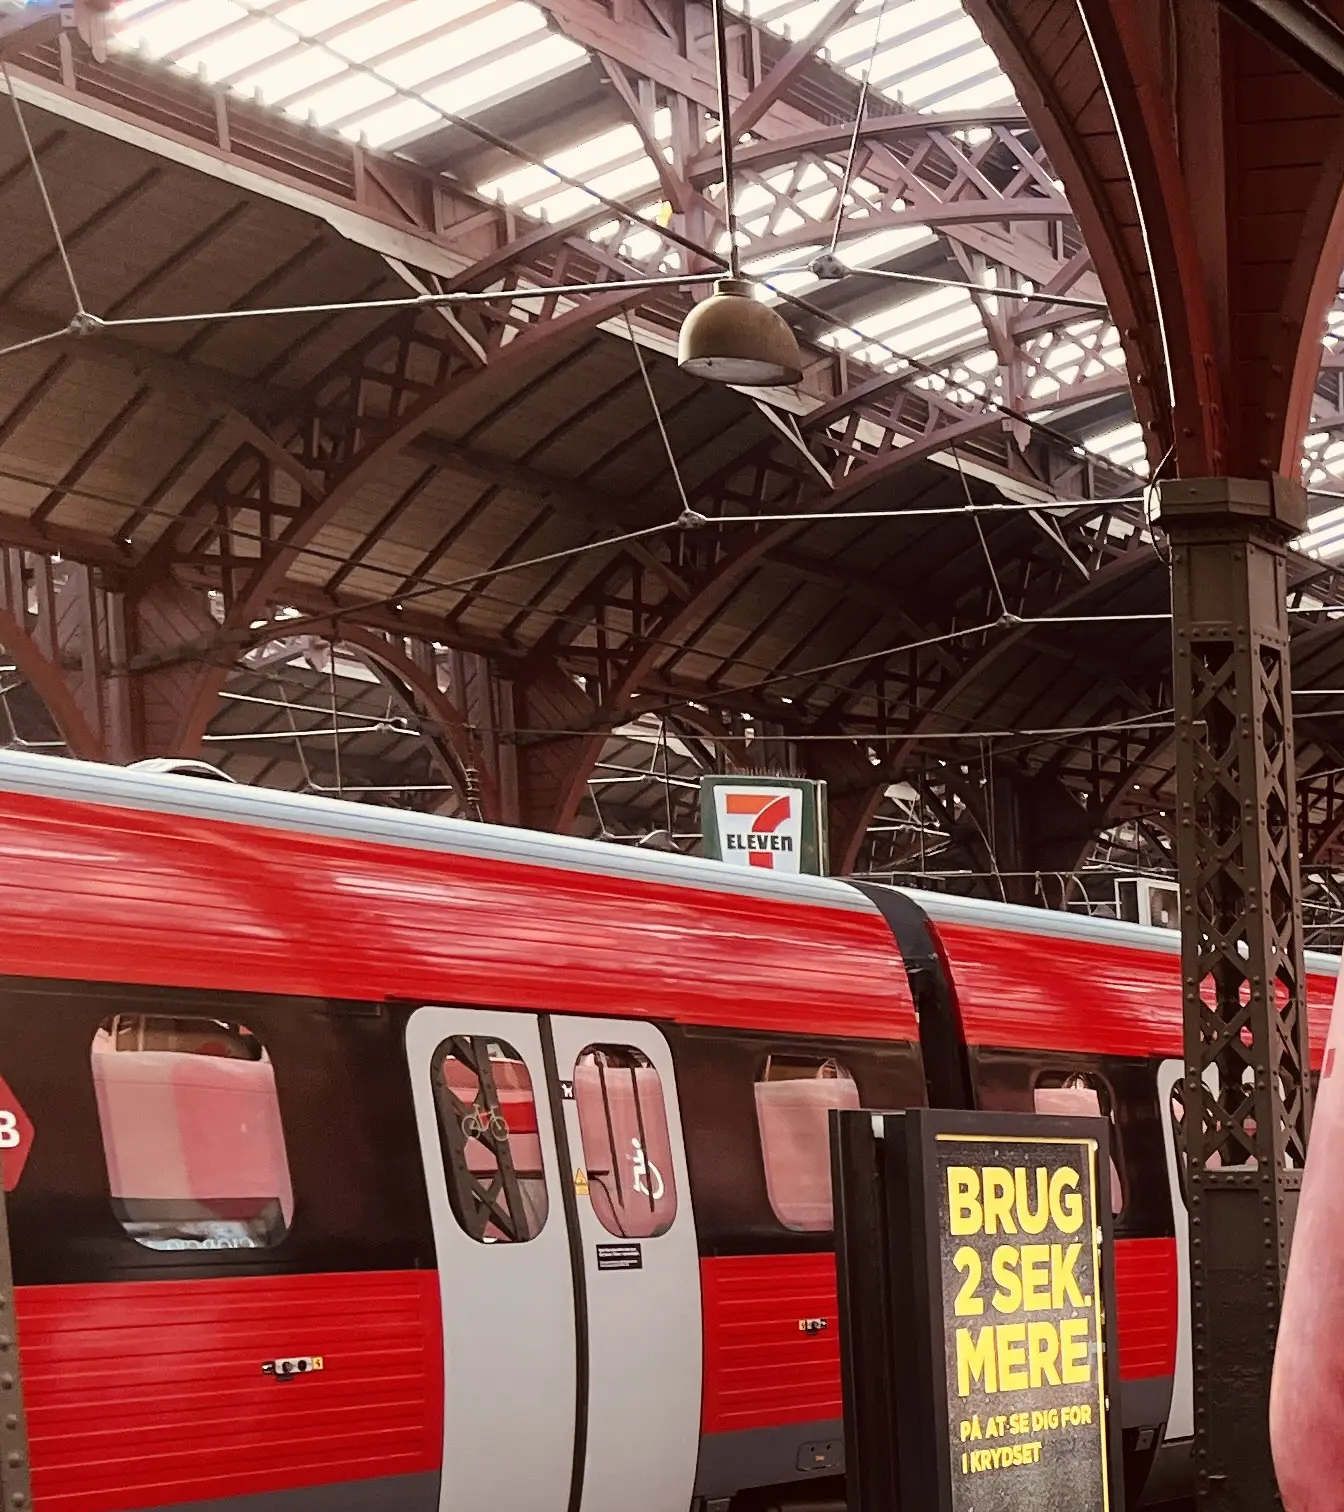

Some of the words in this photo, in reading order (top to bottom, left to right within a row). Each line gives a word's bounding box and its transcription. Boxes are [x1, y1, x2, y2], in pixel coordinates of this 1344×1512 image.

[726, 793, 791, 869] 7
[947, 1166, 1083, 1236] BRUG
[953, 1245, 984, 1316] 2
[991, 1242, 1092, 1315] SEK.
[956, 1318, 1090, 1397] MERE
[960, 1414, 982, 1442] PÅ
[985, 1415, 1007, 1438] AT
[1010, 1412, 1029, 1434] SE
[1032, 1408, 1059, 1432] DIG
[1061, 1404, 1091, 1427] FOR
[962, 1453, 968, 1474] I
[971, 1441, 1042, 1473] KRYDSET
